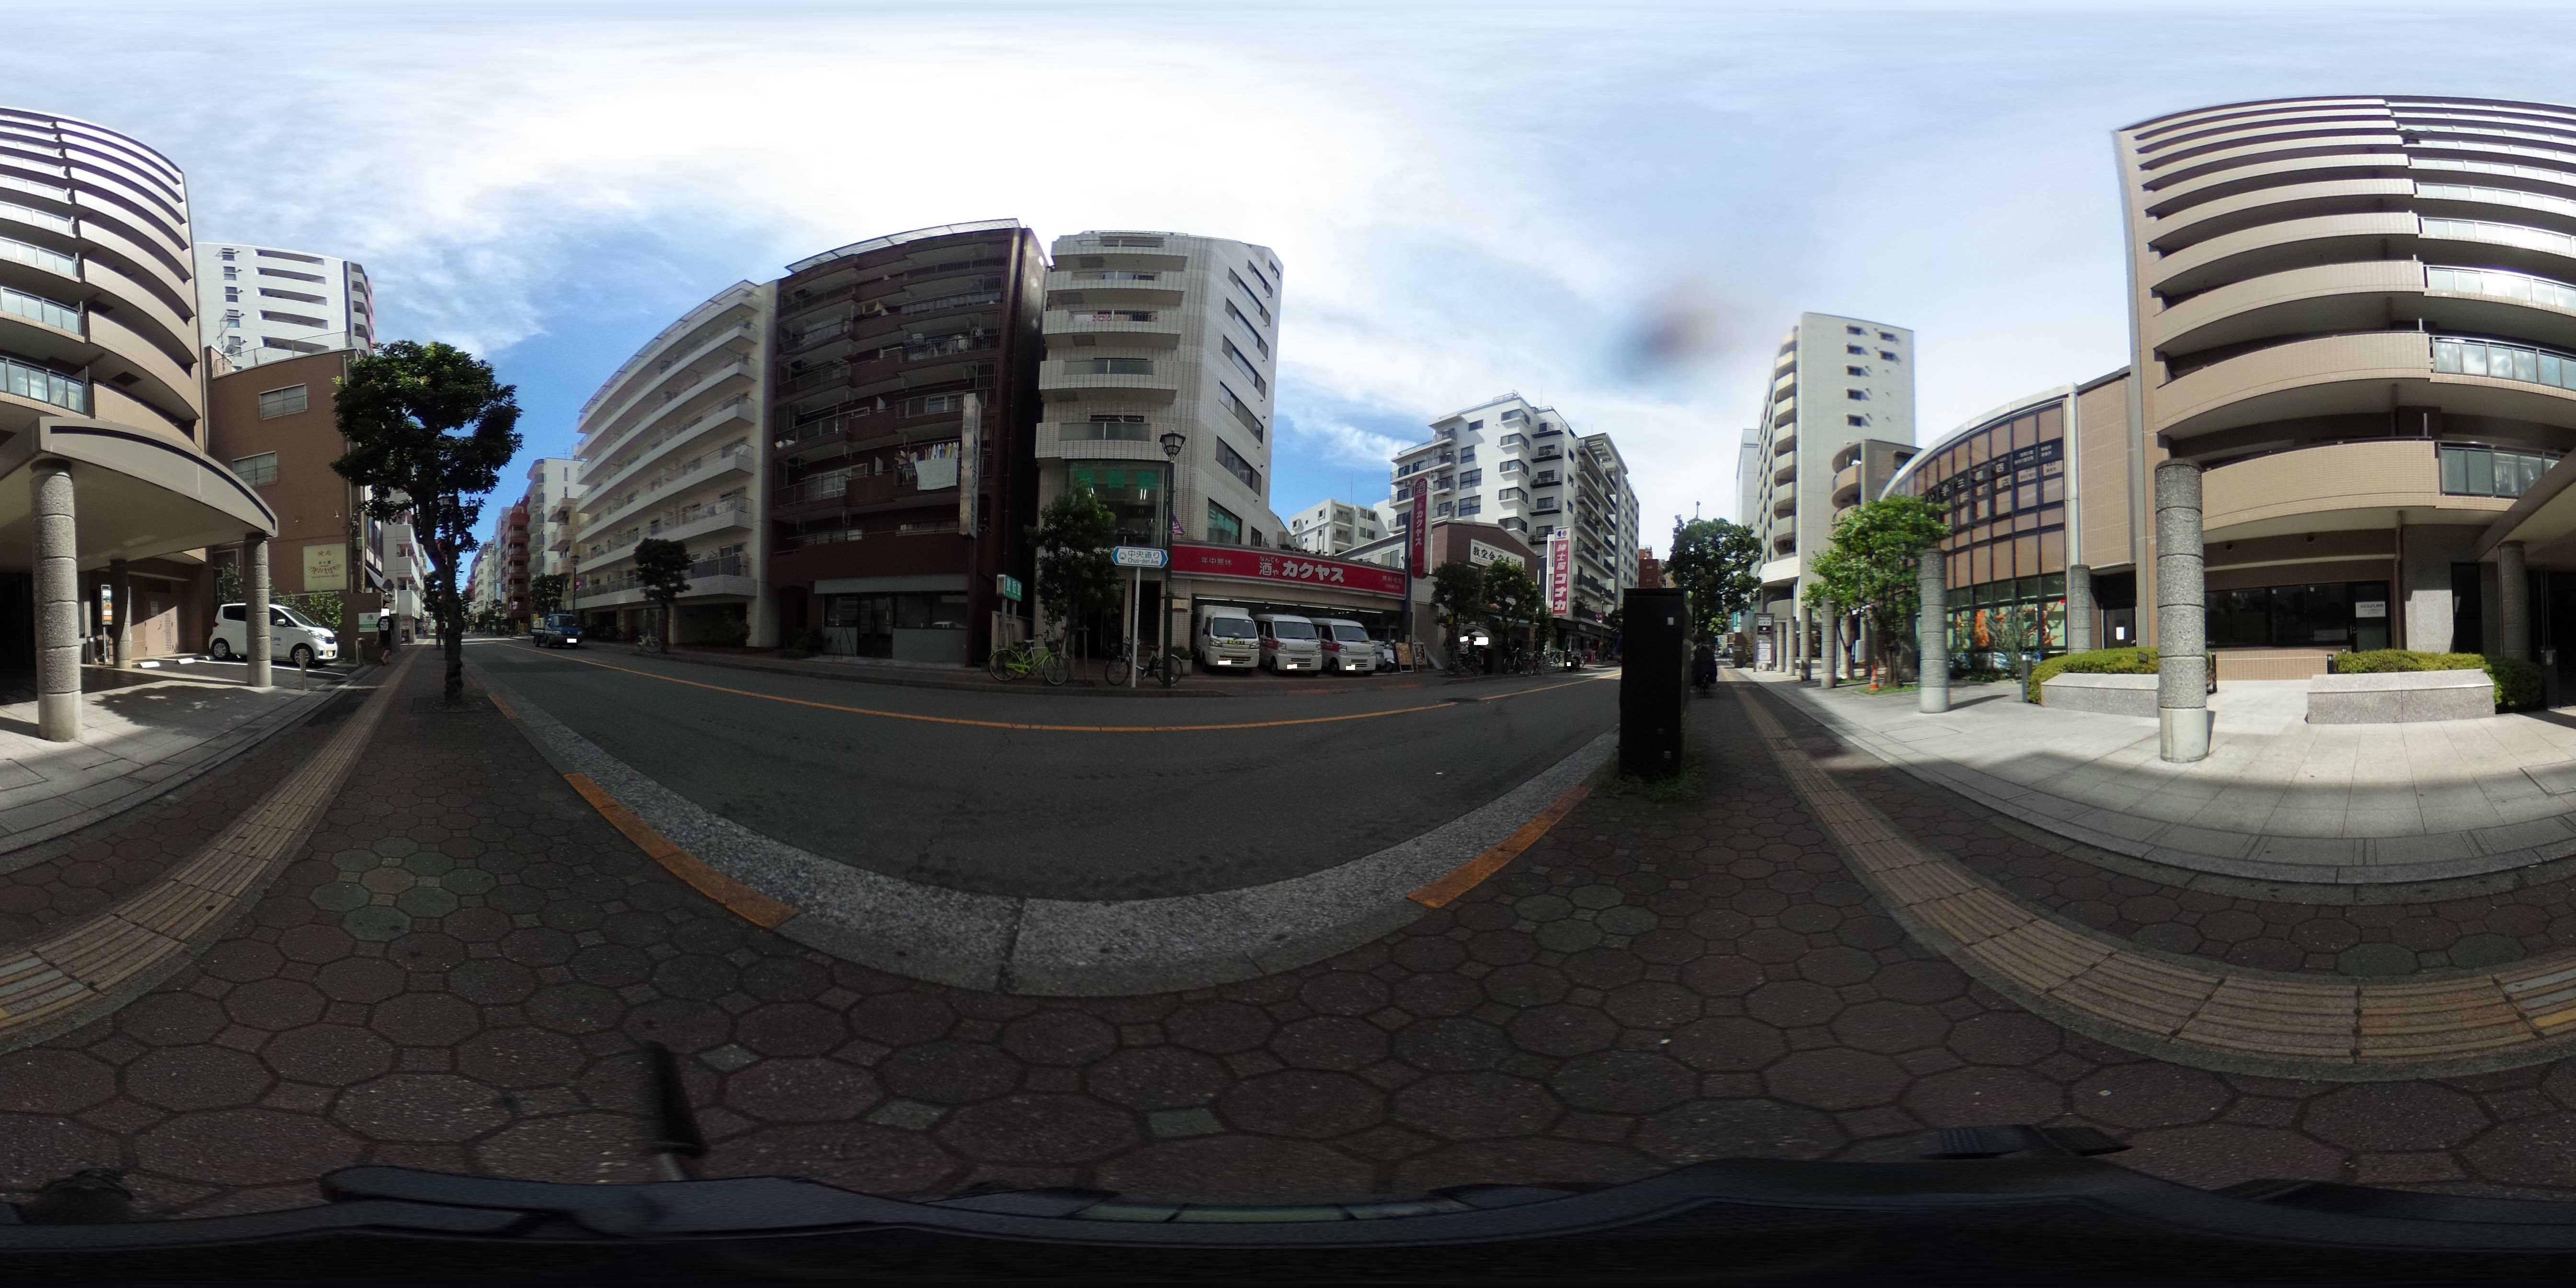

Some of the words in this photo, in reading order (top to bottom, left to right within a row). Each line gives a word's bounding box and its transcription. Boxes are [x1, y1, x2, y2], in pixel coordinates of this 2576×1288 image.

[1415, 510, 1424, 547] カクヤス
[1128, 550, 1160, 559] 中央通り
[1201, 557, 1232, 566] 年中無休
[1282, 560, 1345, 584] カクヤス
